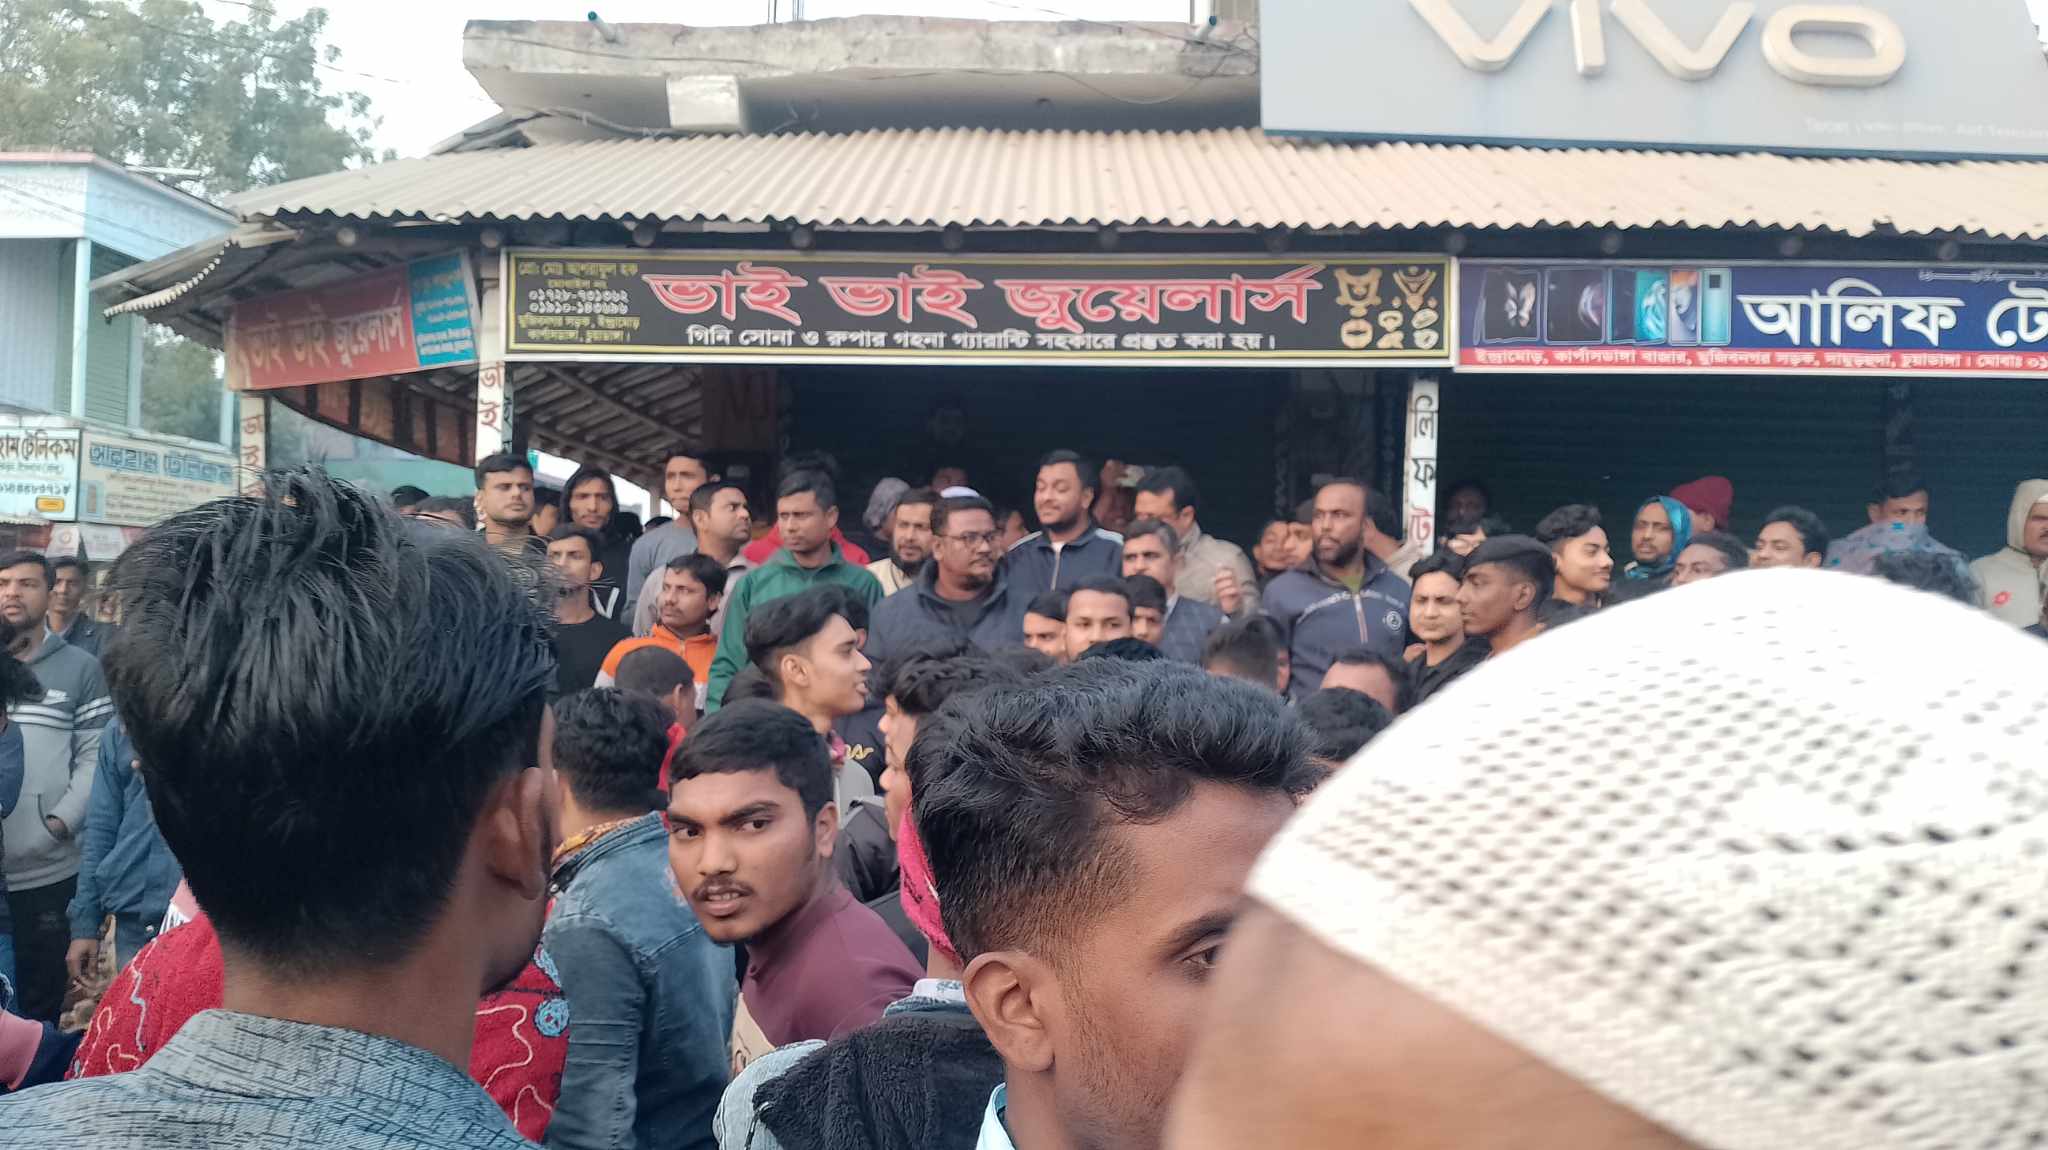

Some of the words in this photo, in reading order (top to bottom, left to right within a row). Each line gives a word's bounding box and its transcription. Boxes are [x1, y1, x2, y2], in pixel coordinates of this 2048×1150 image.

[641, 261, 808, 327] ভাই
[818, 264, 985, 329] ভাই
[994, 263, 1326, 333] জুয়েলার্স
[1736, 277, 1966, 347] আলিফ
[1986, 280, 2048, 348] টে
[686, 324, 734, 347] গিনি
[738, 329, 795, 347] সোনা
[800, 330, 820, 347] ও
[893, 330, 945, 349] গহনা
[1035, 333, 1117, 351] সহকারে
[1182, 333, 1225, 350] করা
[22, 429, 76, 460] টেলিকম
